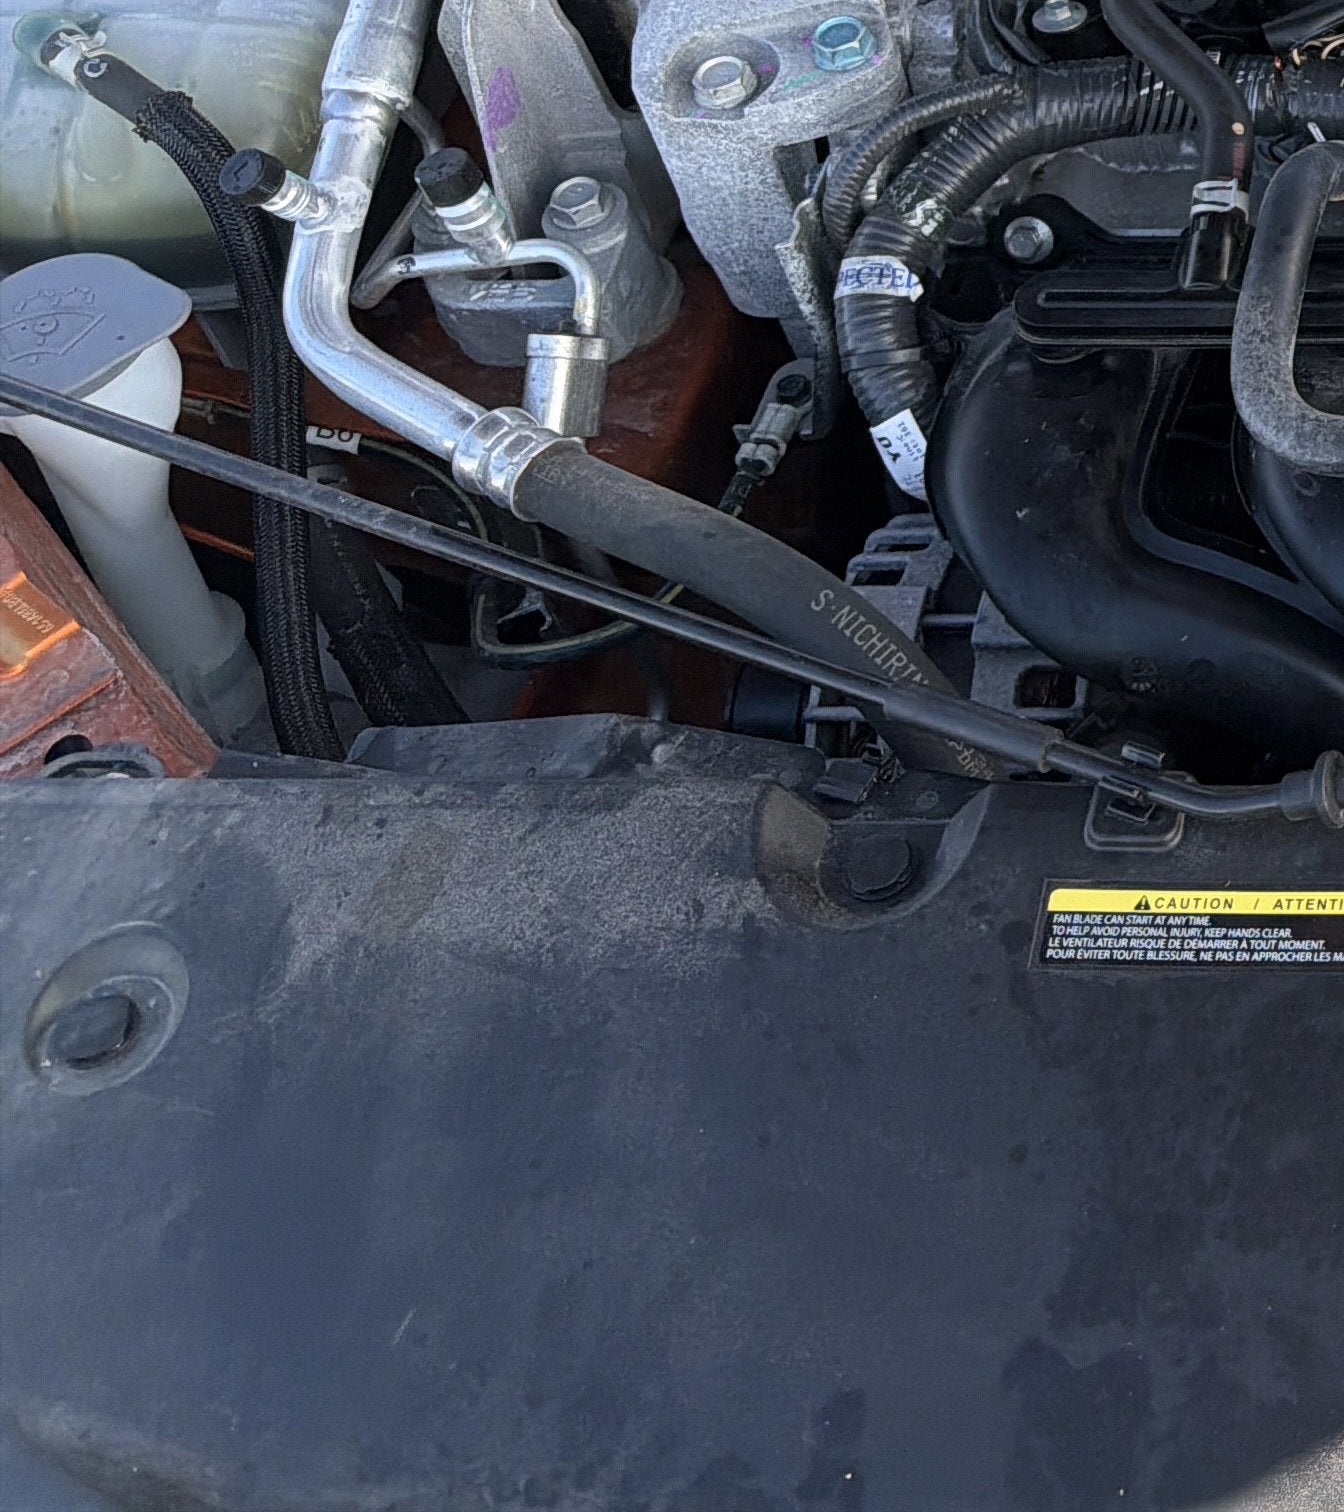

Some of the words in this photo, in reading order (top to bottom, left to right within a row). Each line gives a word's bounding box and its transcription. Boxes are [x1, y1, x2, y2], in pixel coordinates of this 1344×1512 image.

[1154, 897, 1234, 910] CAUTION
[1253, 897, 1261, 911] /
[1053, 914, 1071, 924] FAN
[1072, 914, 1103, 925] BLADE
[1104, 915, 1125, 925] CAN
[1126, 915, 1153, 925] START
[1154, 915, 1166, 925] AT
[1052, 925, 1066, 935] TO
[1066, 926, 1090, 936] HELP
[1090, 926, 1120, 936] AVOID
[1121, 926, 1168, 937] PERSONAL
[1170, 927, 1202, 938] INJURY,
[1204, 928, 1227, 938] KEEP
[1228, 928, 1261, 938] HANDS
[1262, 928, 1293, 939] CLEAR.
[1048, 937, 1061, 947] LE
[1062, 938, 1128, 948] VENTILATEUR
[1129, 938, 1166, 949] RISQUE
[1167, 939, 1182, 949] DE
[1183, 937, 1239, 950] DÉMARRER
[1249, 940, 1277, 950] TOUT
[1278, 940, 1326, 951] MOMENT.
[1046, 949, 1075, 959] POUR
[1076, 947, 1111, 959] ÉVITER
[1111, 950, 1145, 960] TOUTE
[1146, 951, 1198, 962] BLESSURE,
[1199, 951, 1214, 961] NE
[1215, 951, 1235, 962] PAS
[1236, 951, 1251, 962] EN
[1251, 951, 1313, 962] APPROCHER
[1313, 952, 1331, 962] LES
